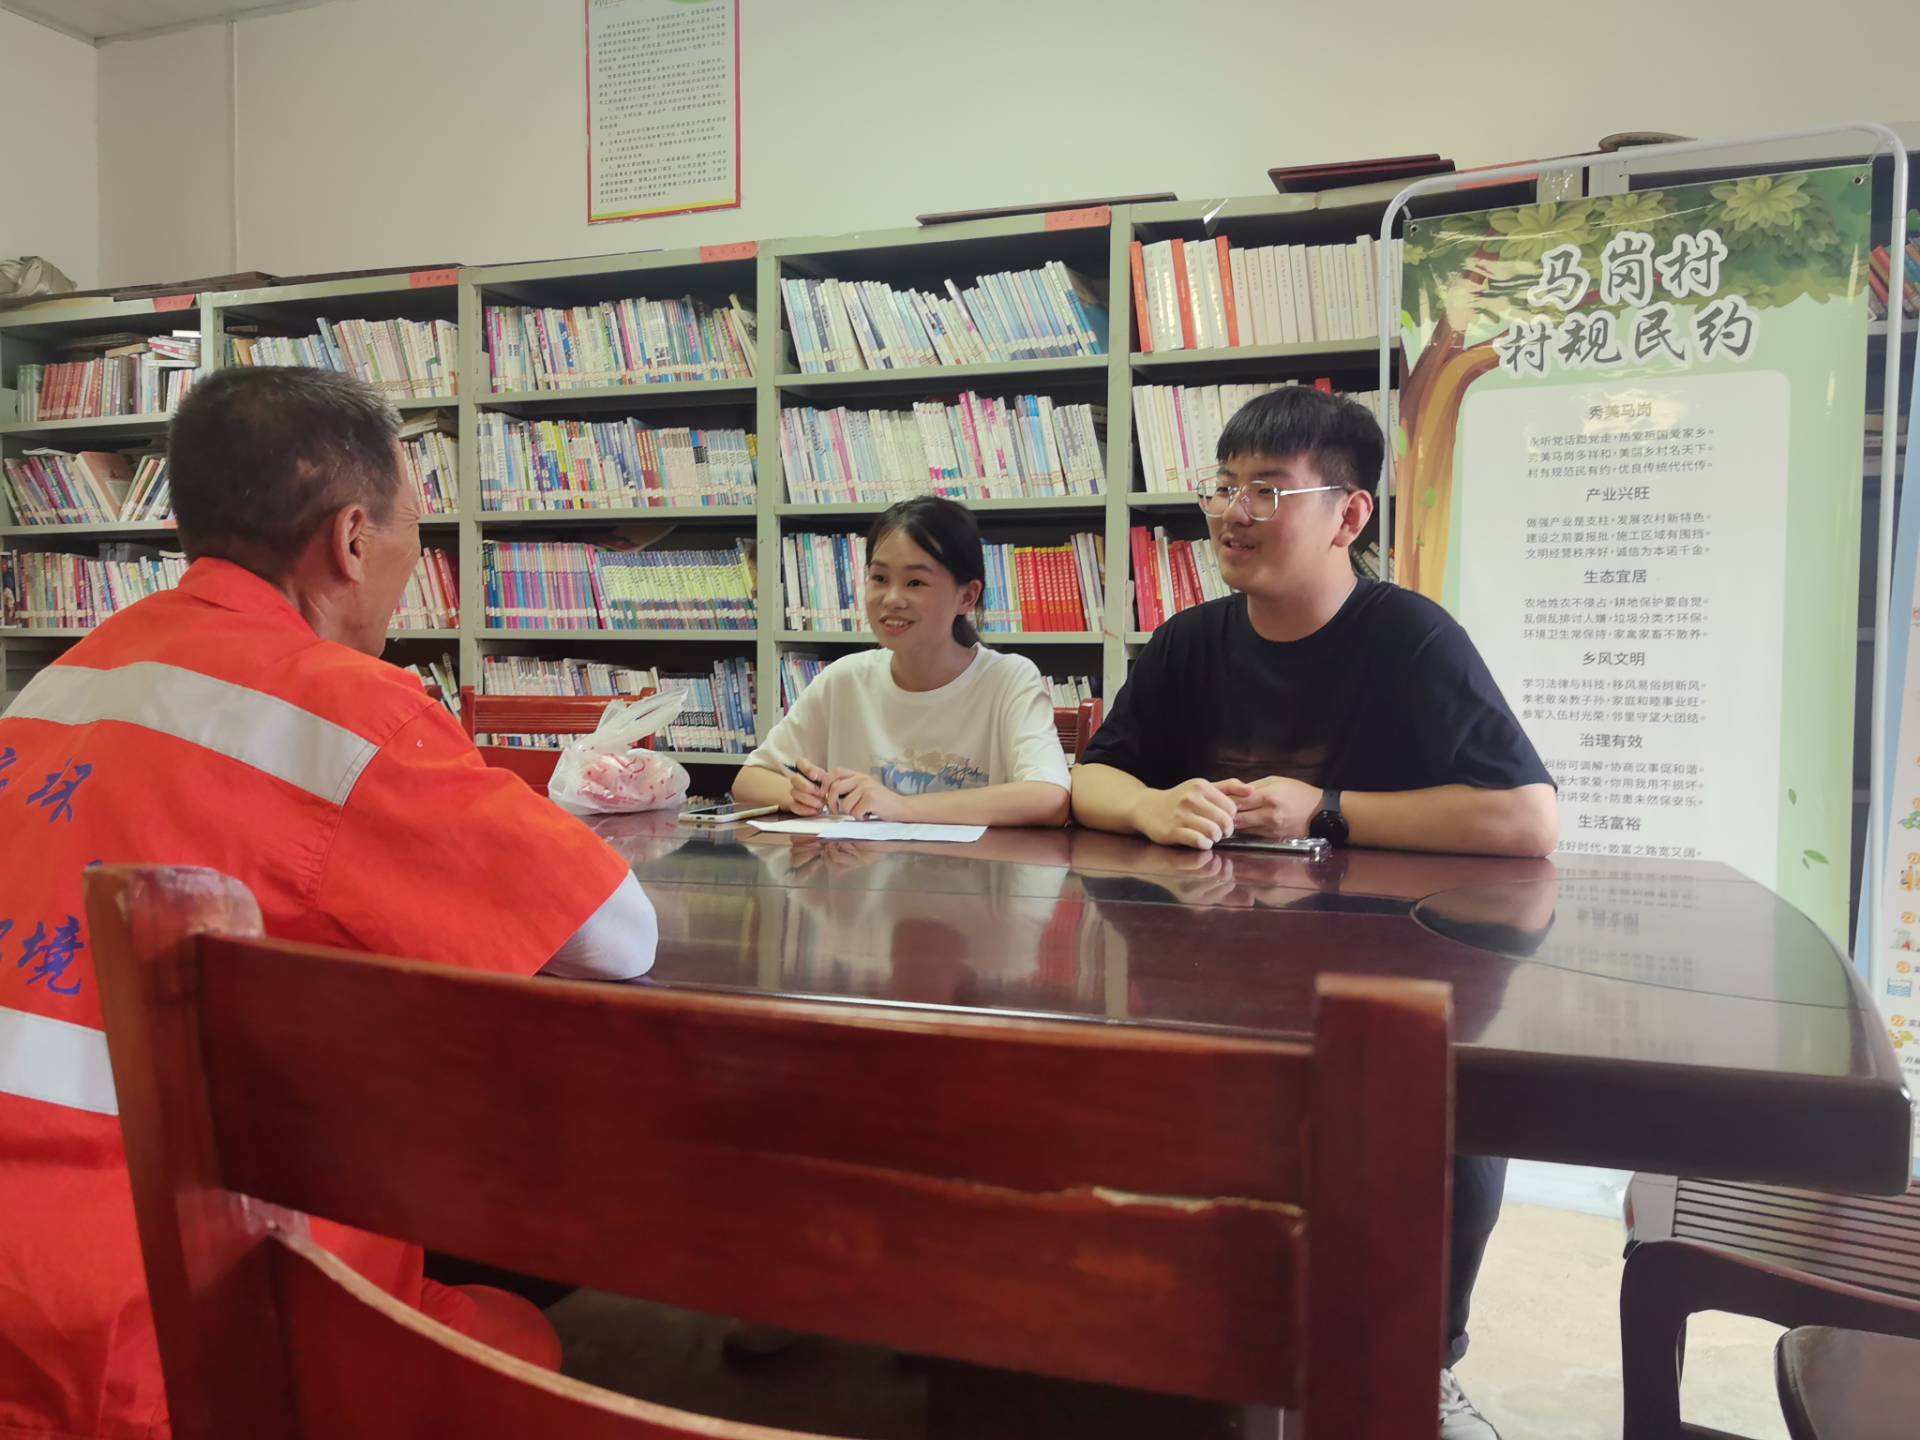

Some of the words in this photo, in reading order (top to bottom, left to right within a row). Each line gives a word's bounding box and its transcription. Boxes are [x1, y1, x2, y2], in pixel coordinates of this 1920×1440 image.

[1534, 233, 1724, 305] 马岗村
[1502, 304, 1754, 376] 村规民约
[1588, 402, 1652, 419] 秀美马岗
[1586, 486, 1650, 502] 产业兴旺
[1583, 569, 1648, 584] 生态宜居
[1582, 651, 1646, 667] 乡风文明
[1579, 733, 1644, 749] 治理有效
[1577, 814, 1641, 831] 生活富裕
